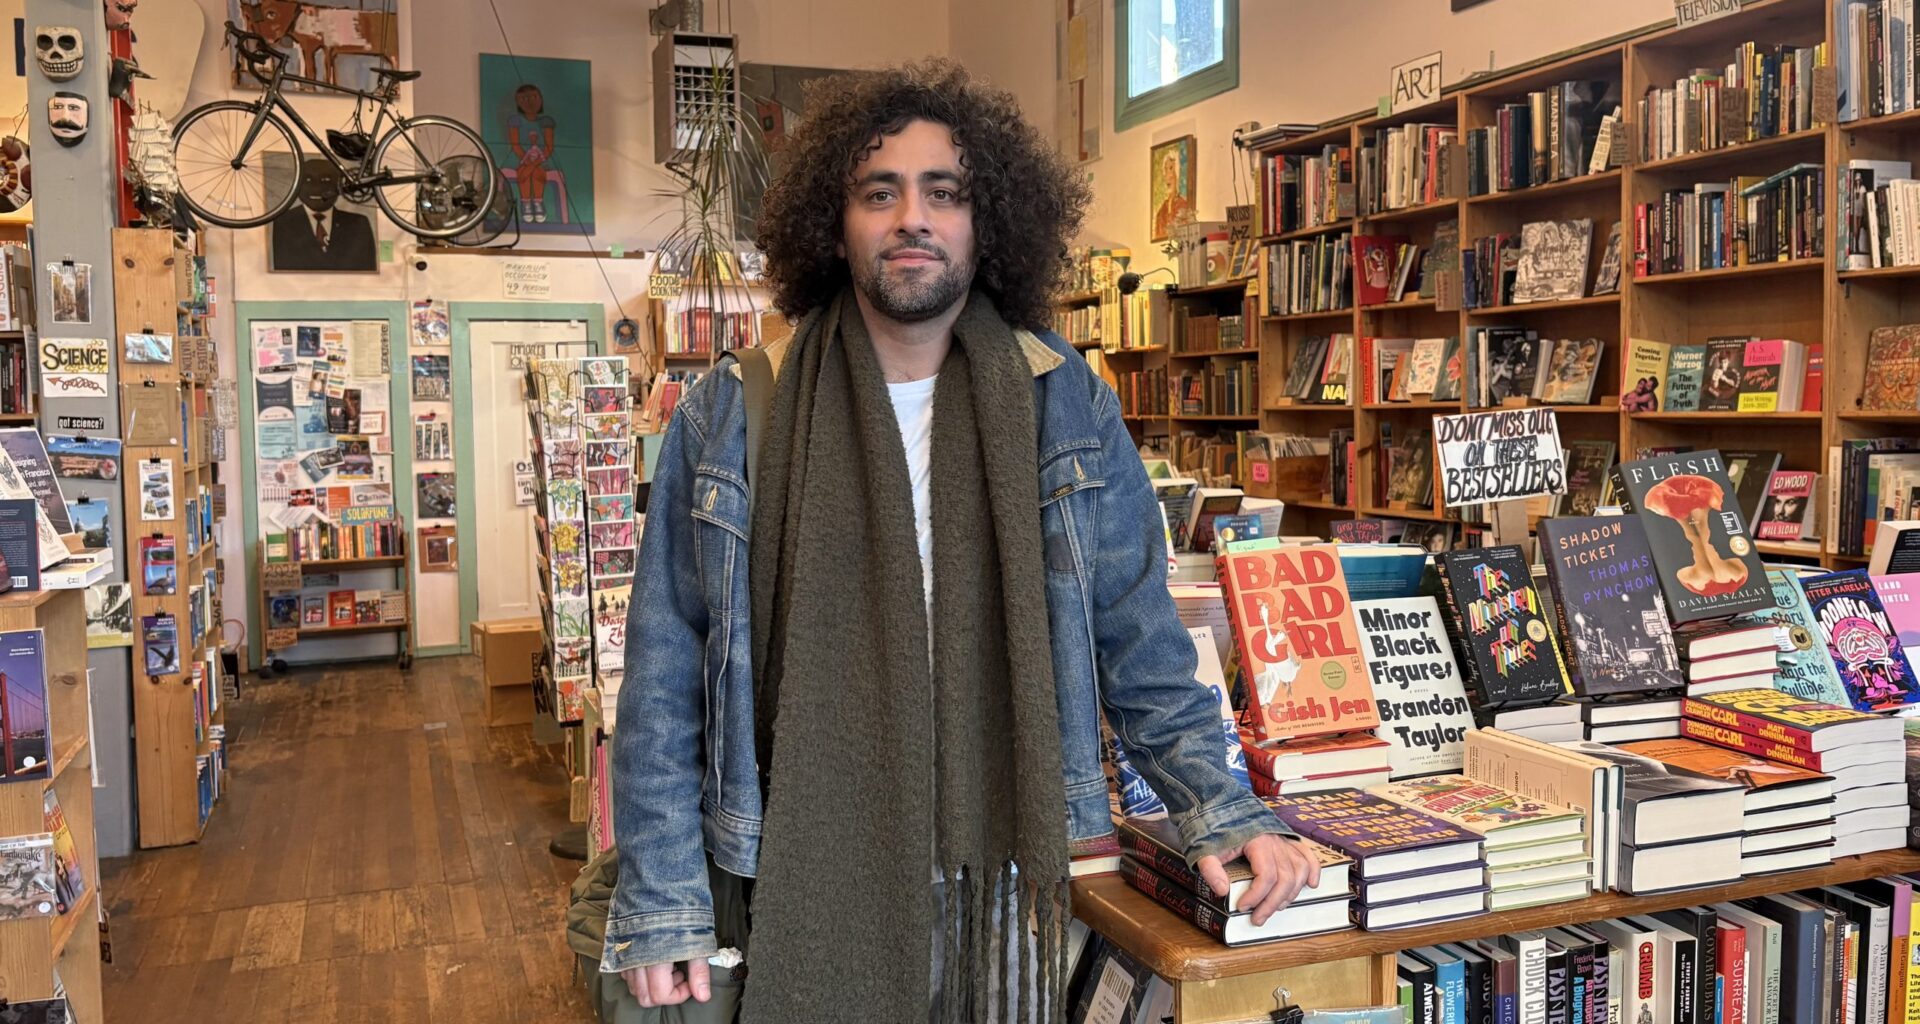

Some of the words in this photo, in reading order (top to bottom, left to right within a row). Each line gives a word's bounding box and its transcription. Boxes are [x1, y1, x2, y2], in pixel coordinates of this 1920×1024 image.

[1395, 61, 1440, 105] ART
[1550, 94, 1560, 160] MANDELA
[506, 282, 520, 290] 49
[1635, 352, 1662, 362] Together
[1637, 346, 1661, 355] Coming
[1673, 351, 1704, 362] Werner
[1672, 359, 1702, 370] Herzog
[1672, 382, 1697, 391] Future
[1678, 374, 1692, 382] The
[1672, 400, 1693, 408] Truth
[1679, 391, 1688, 399] of
[58, 417, 71, 429] got
[72, 417, 104, 429] science?
[1487, 410, 1526, 441] MISS
[1527, 408, 1554, 435] OUT
[1463, 441, 1487, 467] ON
[1489, 434, 1539, 464] THESE
[24, 468, 51, 478] Francisco
[1631, 456, 1721, 484] FLESH
[1446, 458, 1564, 505] BESTSELLERS
[1773, 476, 1786, 489] ED
[1784, 474, 1808, 488] WOOD
[346, 506, 390, 520] SOLARPUNK
[1559, 522, 1622, 550] SHADOW
[1761, 524, 1778, 535] WILL
[1777, 523, 1799, 535] SLOAN
[1563, 543, 1616, 569] TICKET
[1232, 550, 1336, 591] BAD
[1588, 555, 1650, 582] THOMAS
[1583, 574, 1655, 605] PYNCHON
[1678, 595, 1718, 609] DAVID
[1722, 586, 1767, 603] SZALAY
[1834, 581, 1871, 595] KARELLA
[1240, 585, 1345, 628] BAD
[1467, 585, 1538, 637] Ministry
[1359, 607, 1432, 632] Minor
[1250, 620, 1358, 664] GIRL
[1370, 631, 1443, 658] Black
[1555, 603, 1569, 637] SHADOW
[1564, 639, 1576, 667] TICKET
[1368, 660, 1452, 690] Figures
[1808, 662, 1827, 674] the
[1267, 697, 1327, 724] Gish
[1329, 696, 1371, 722] Jen
[1376, 693, 1469, 722] Brandon
[1685, 706, 1712, 720] CRAWLER
[1686, 698, 1711, 713] DUNGEON
[1687, 719, 1716, 732] DUNGEON
[1711, 707, 1740, 727] CARL
[1394, 722, 1467, 752] Taylor
[1686, 726, 1715, 741] CRAWLER
[1758, 728, 1796, 746] DINNIMAN
[1766, 722, 1786, 734] MATT
[1714, 729, 1746, 748] CARL
[1775, 742, 1795, 755] MATT
[1766, 747, 1806, 766] DINNIMAN
[1295, 803, 1396, 822] ANDERS
[1298, 800, 1362, 812] JANE
[1317, 812, 1419, 831] LESSONS
[1332, 826, 1360, 837] IN
[1368, 819, 1433, 833] MAGIC
[1355, 829, 1461, 849] DISASTER
[1379, 829, 1413, 838] AND
[1872, 943, 1879, 953] On
[1879, 944, 1888, 970] Man
[1524, 947, 1546, 997] CHUCK
[1638, 941, 1654, 1000] CRUMB
[1704, 925, 1716, 1021] COVARRUBIAS
[1871, 955, 1879, 976] Sitting
[1899, 956, 1907, 988] Gauguin
[1482, 973, 1492, 1009] JUDY
[1585, 979, 1594, 991] An
[1879, 973, 1888, 996] with
[1870, 991, 1878, 1016] Portrait
